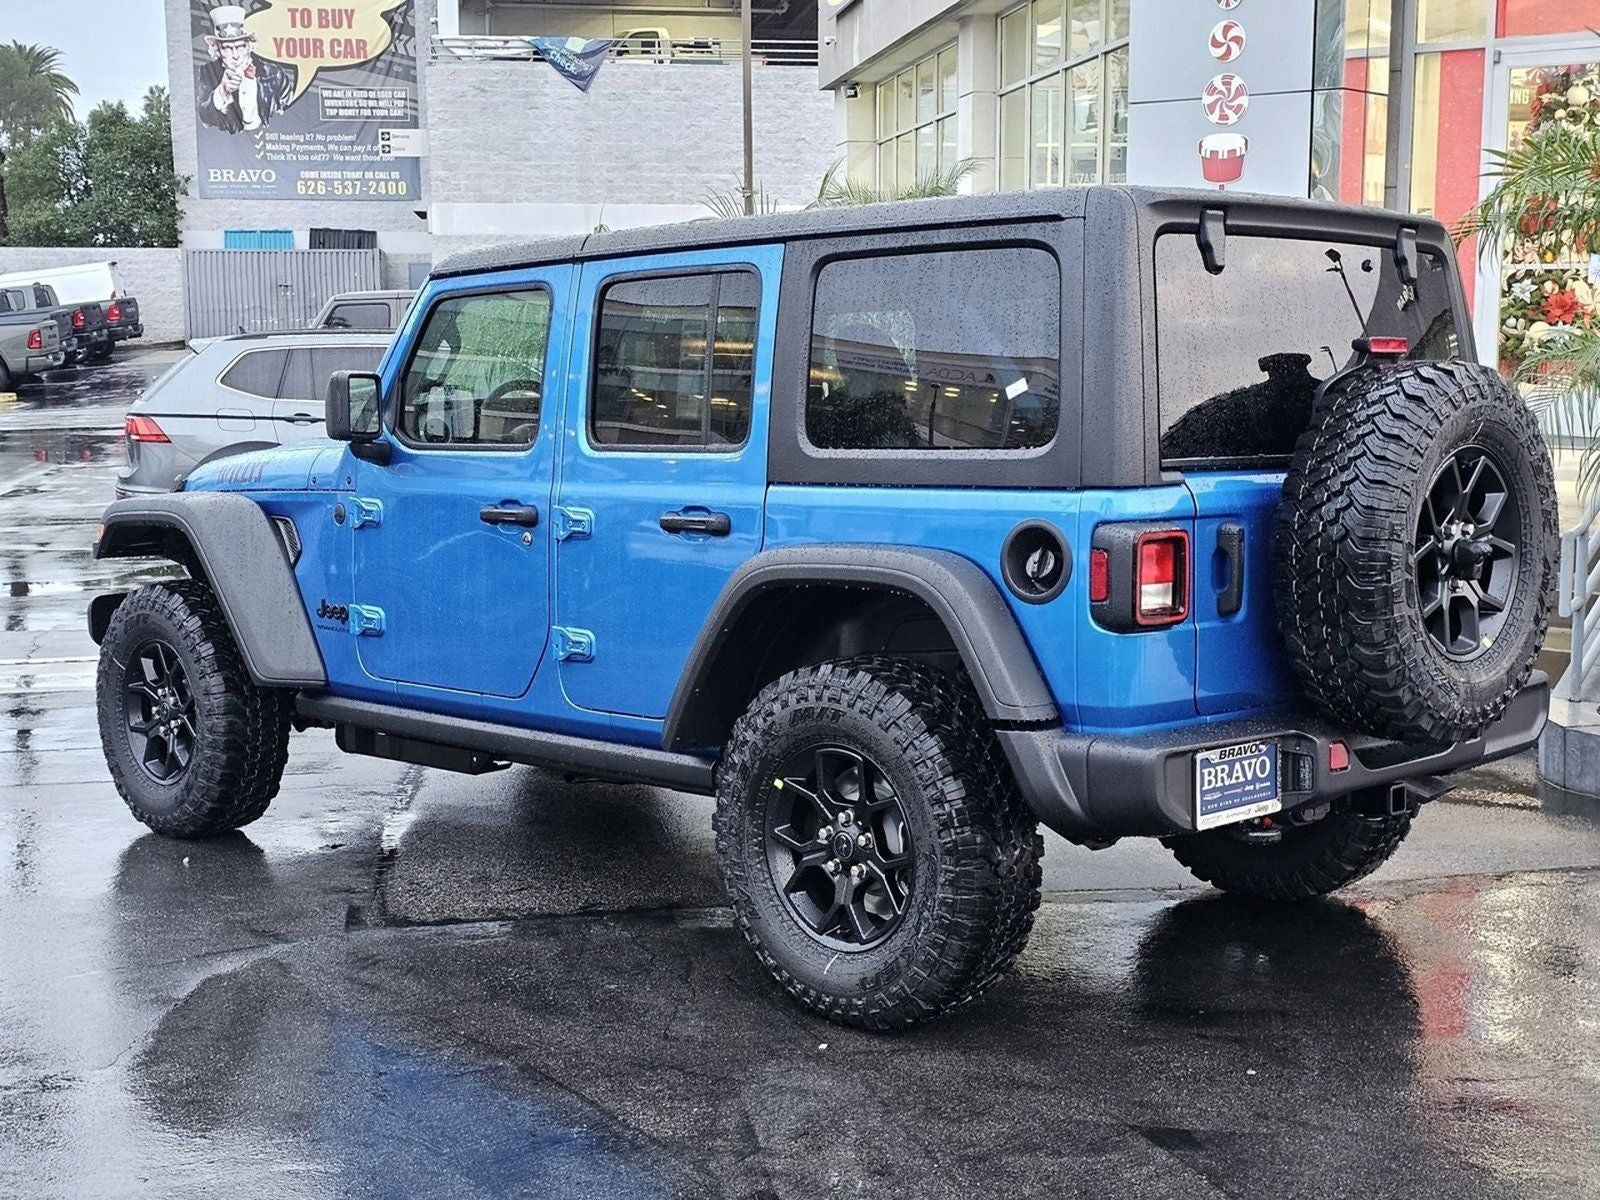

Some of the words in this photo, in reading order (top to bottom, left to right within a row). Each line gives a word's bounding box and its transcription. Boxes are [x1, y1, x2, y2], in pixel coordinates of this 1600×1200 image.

[287, 8, 315, 29] TO
[317, 8, 356, 29] BUY
[272, 37, 325, 59] YOUR
[329, 38, 368, 59] CAR
[549, 50, 578, 75] Check.
[333, 90, 344, 98] ARE
[345, 90, 352, 98] IN
[353, 90, 368, 98] NEED
[369, 90, 376, 98] OF
[377, 90, 392, 98] USED
[359, 99, 367, 107] SO
[393, 100, 405, 108] PAY
[325, 108, 338, 116] TOP
[265, 132, 278, 140] Still
[280, 132, 304, 142] leasing
[305, 132, 314, 140] it?
[315, 133, 326, 141] No
[327, 133, 357, 143] problem!
[265, 142, 290, 152] Making
[291, 143, 327, 153] Payments,
[328, 143, 339, 151] We
[353, 145, 366, 154] pay
[266, 152, 285, 160] Think
[298, 153, 310, 161] too
[333, 153, 344, 161] We
[362, 154, 380, 162] those
[208, 168, 276, 182] BRAVO
[300, 170, 320, 179] COME
[320, 171, 342, 179] INSIDE
[343, 171, 364, 179] TODAY
[365, 171, 374, 179] OR
[375, 171, 390, 179] CALL
[391, 171, 400, 179] US
[297, 180, 407, 195] 626-537-2400
[317, 599, 349, 625] Jeep
[1202, 756, 1271, 791] BRAVO
